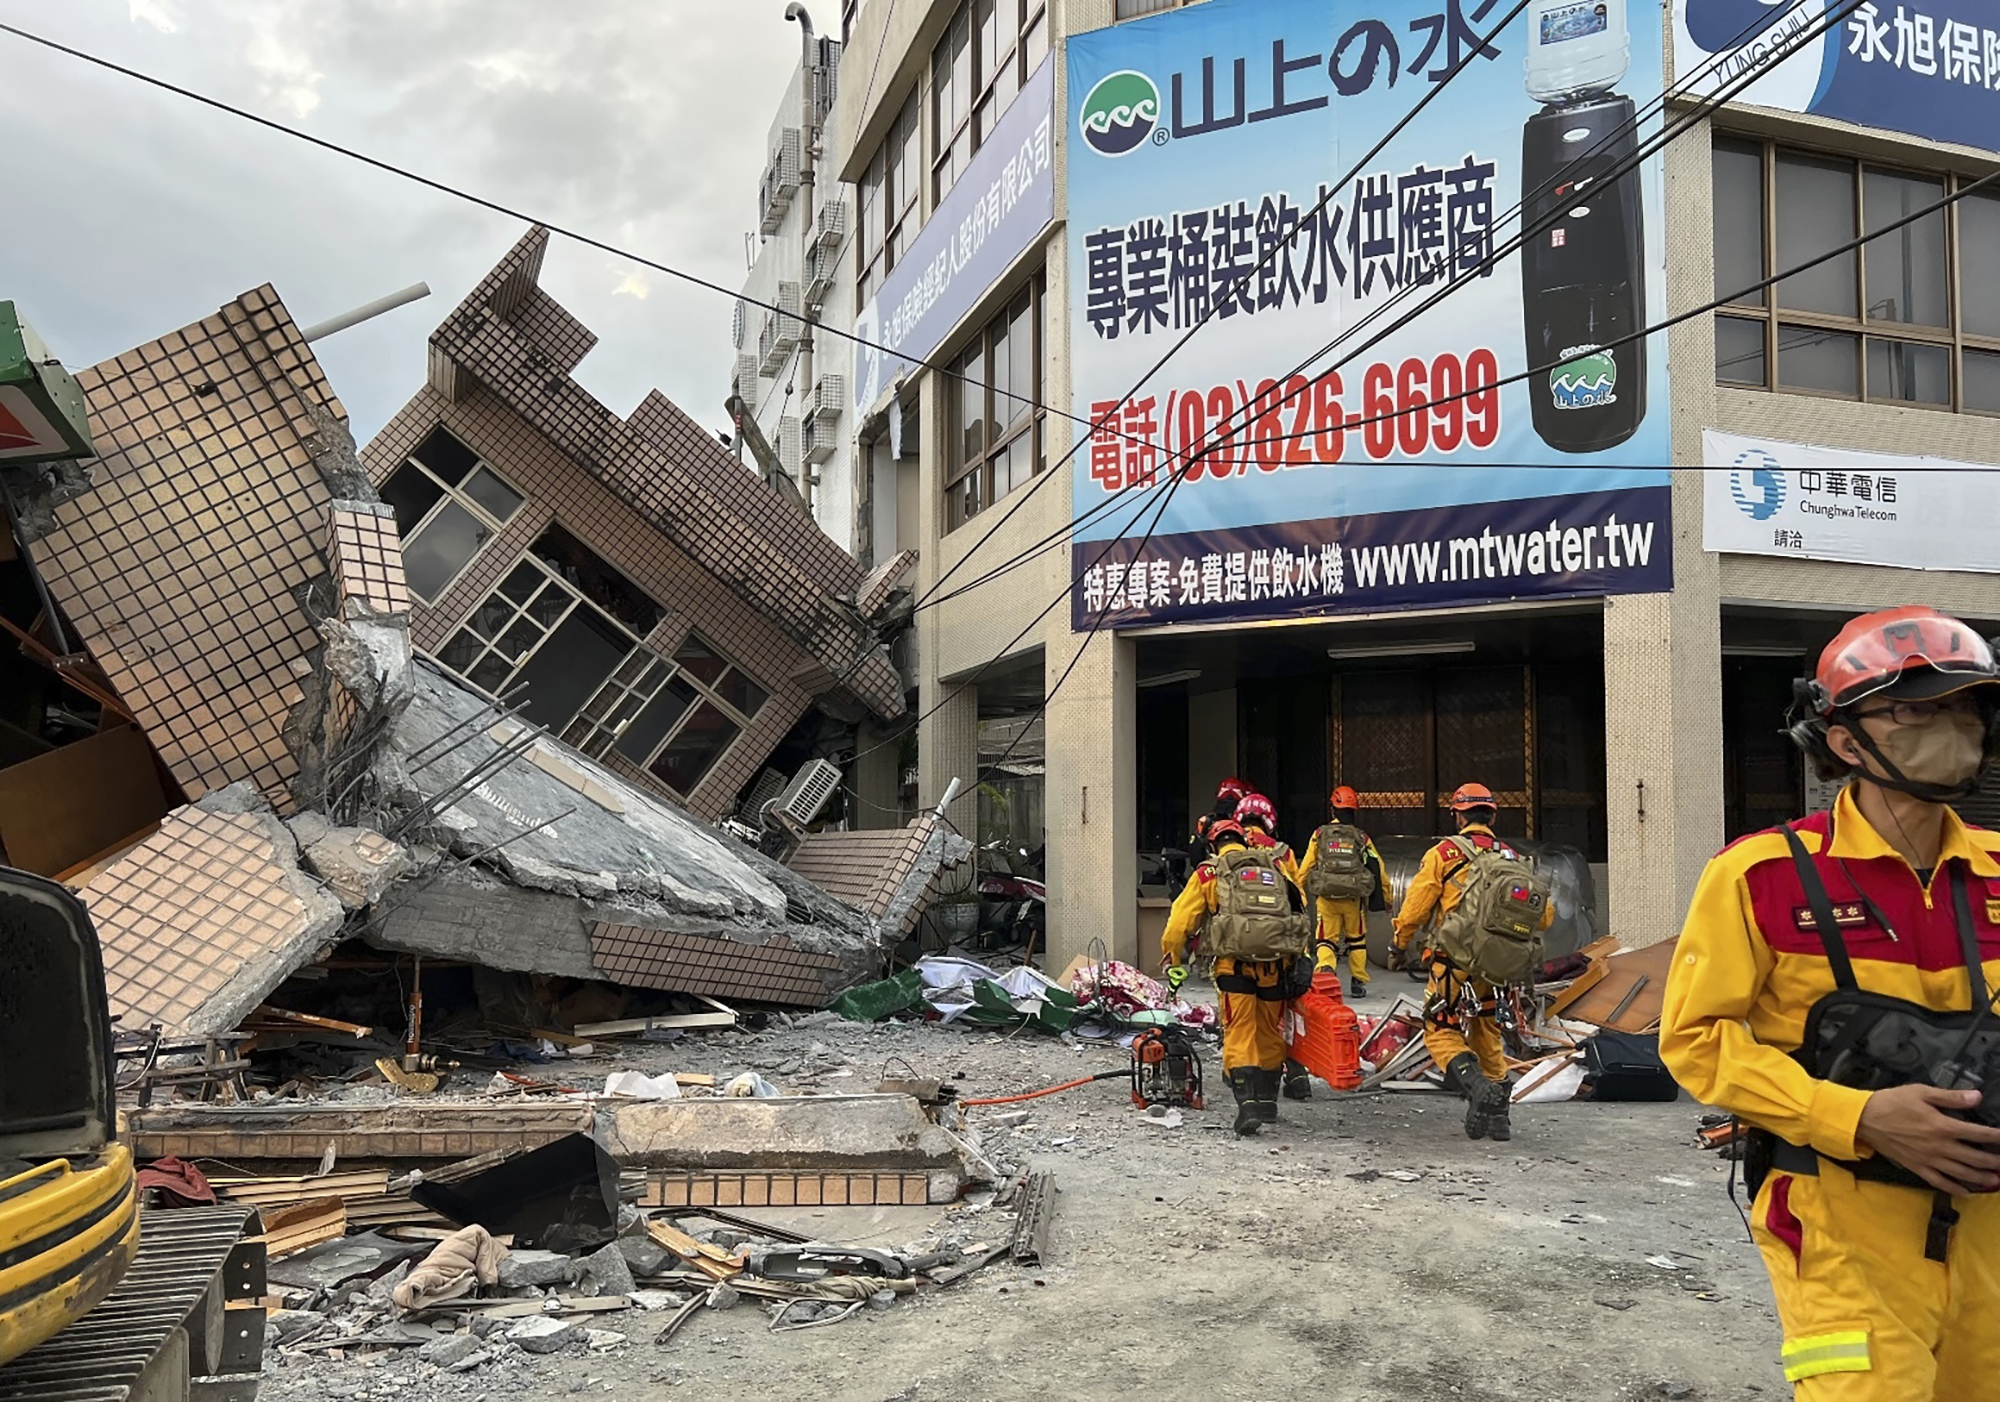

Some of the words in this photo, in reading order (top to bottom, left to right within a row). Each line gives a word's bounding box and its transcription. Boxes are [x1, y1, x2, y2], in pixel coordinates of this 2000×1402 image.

[1171, 0, 1501, 139] 山上の水
[1710, 42, 1771, 84] YUNG
[1086, 154, 1494, 340] 專業桶裝飲水供應商
[1800, 469, 1897, 503] 中華電信
[1800, 500, 1855, 519] Chunghwa
[1855, 505, 1897, 521] Telecom
[1351, 513, 1654, 588] www.mtwater.tw
[1774, 528, 1803, 549] 請洽
